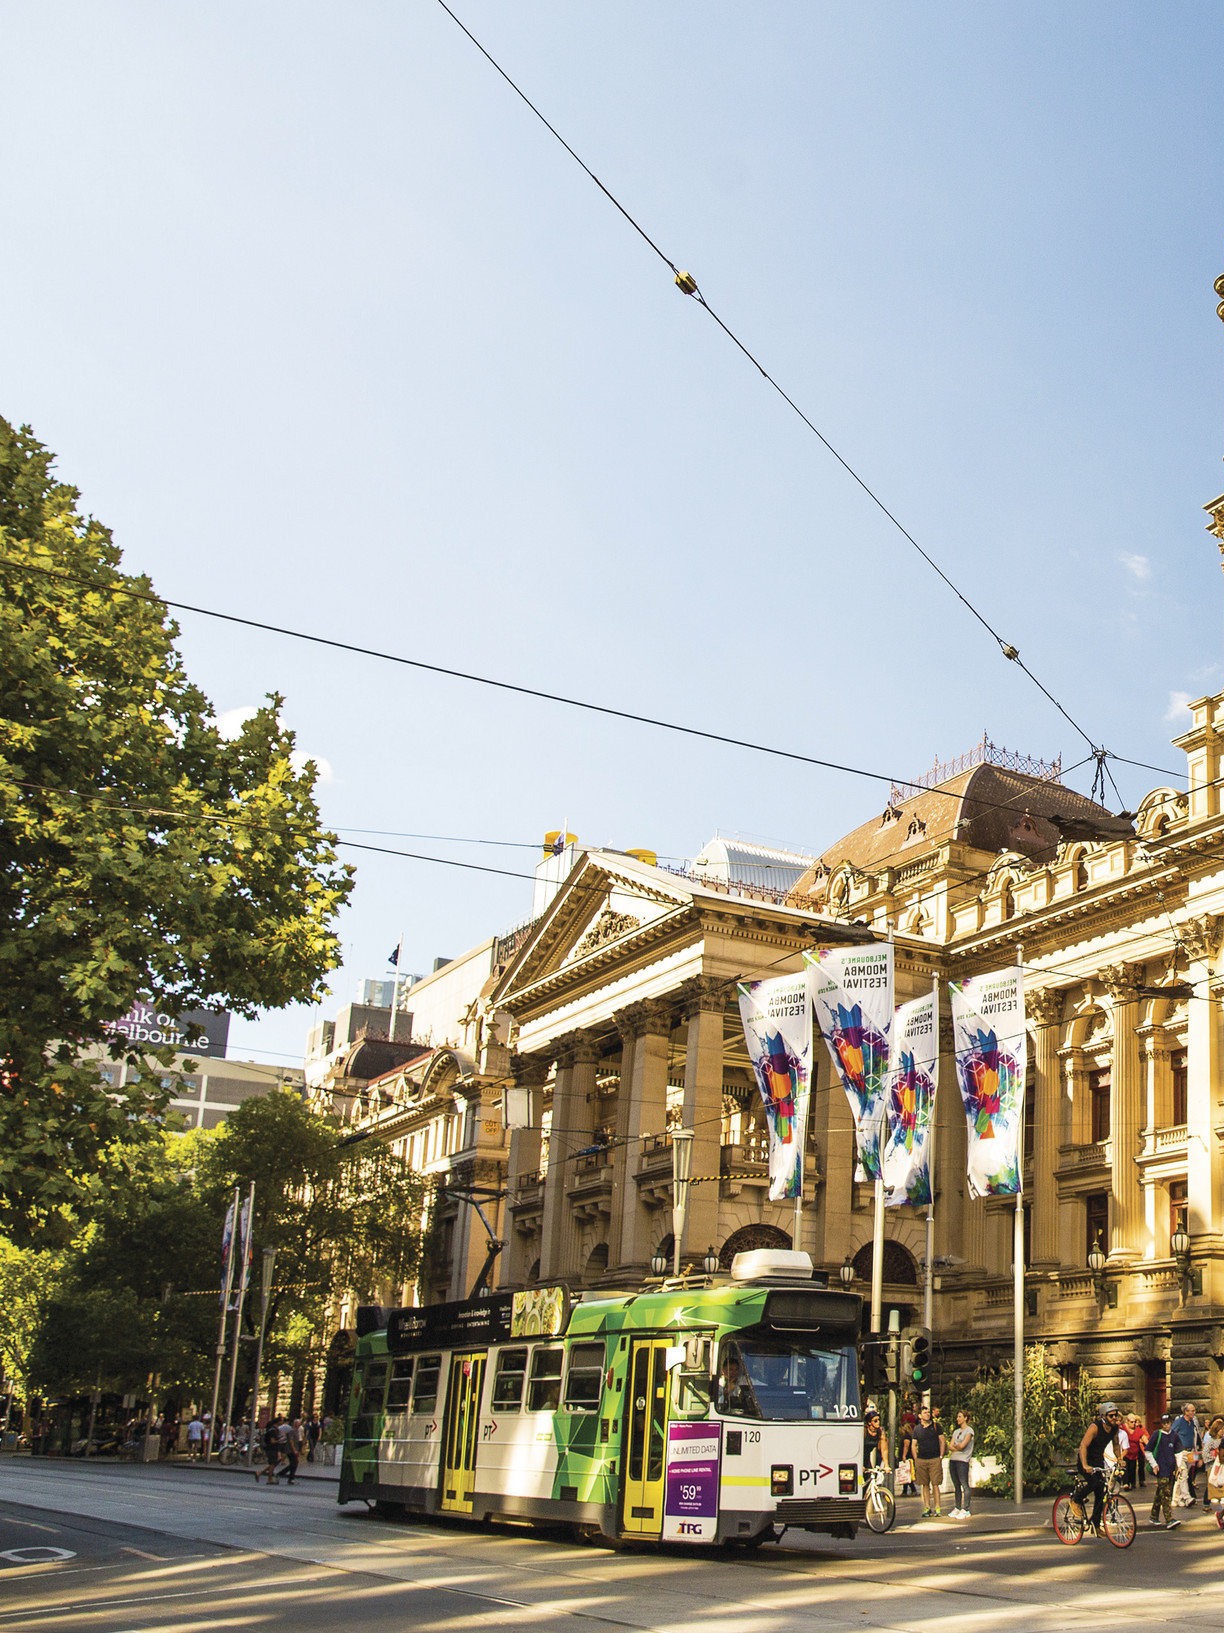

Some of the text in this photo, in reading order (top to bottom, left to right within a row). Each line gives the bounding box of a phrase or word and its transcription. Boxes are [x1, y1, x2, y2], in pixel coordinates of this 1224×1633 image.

[833, 1404, 858, 1418] 120
[744, 1431, 761, 1443] 120
[701, 1444, 717, 1454] DATA
